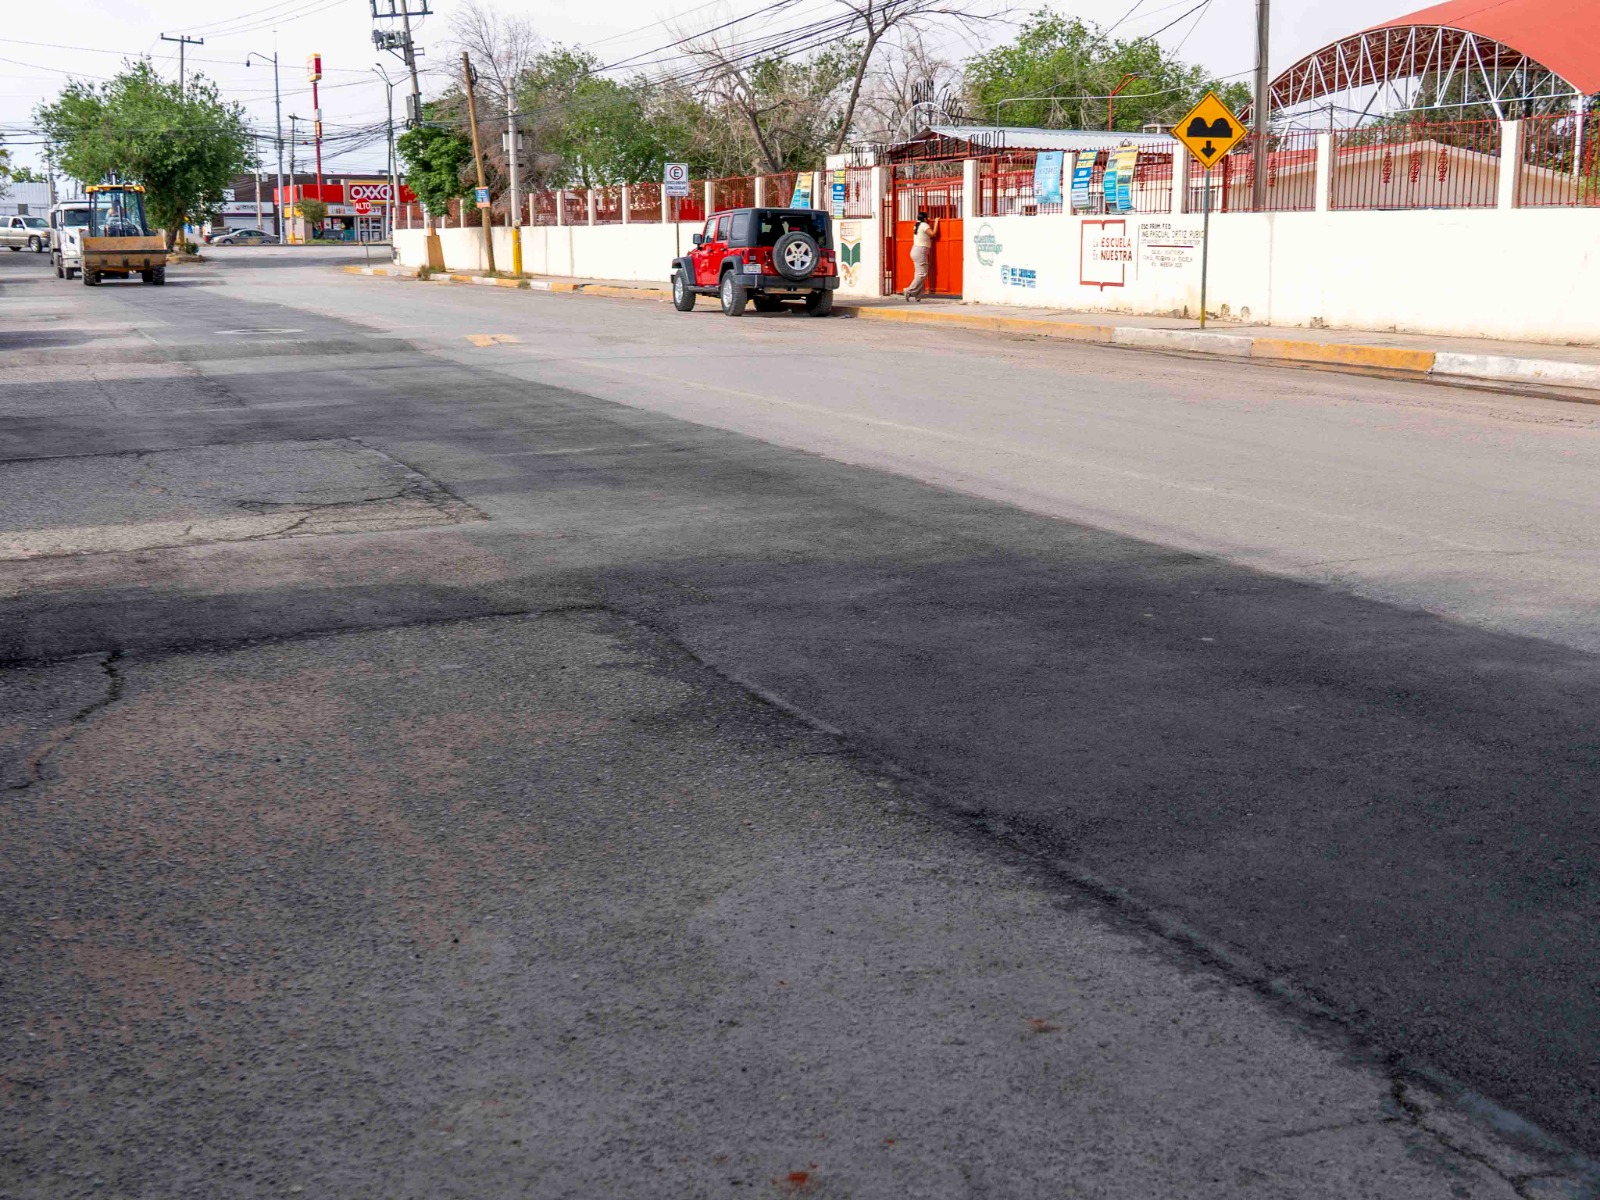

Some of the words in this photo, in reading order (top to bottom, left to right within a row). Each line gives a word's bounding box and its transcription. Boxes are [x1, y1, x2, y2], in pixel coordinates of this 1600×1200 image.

[673, 168, 680, 177] E
[351, 184, 392, 199] OXXO
[355, 202, 371, 210] ALTO
[1101, 237, 1131, 248] ESCUELA
[1101, 250, 1132, 261] NUESTRA
